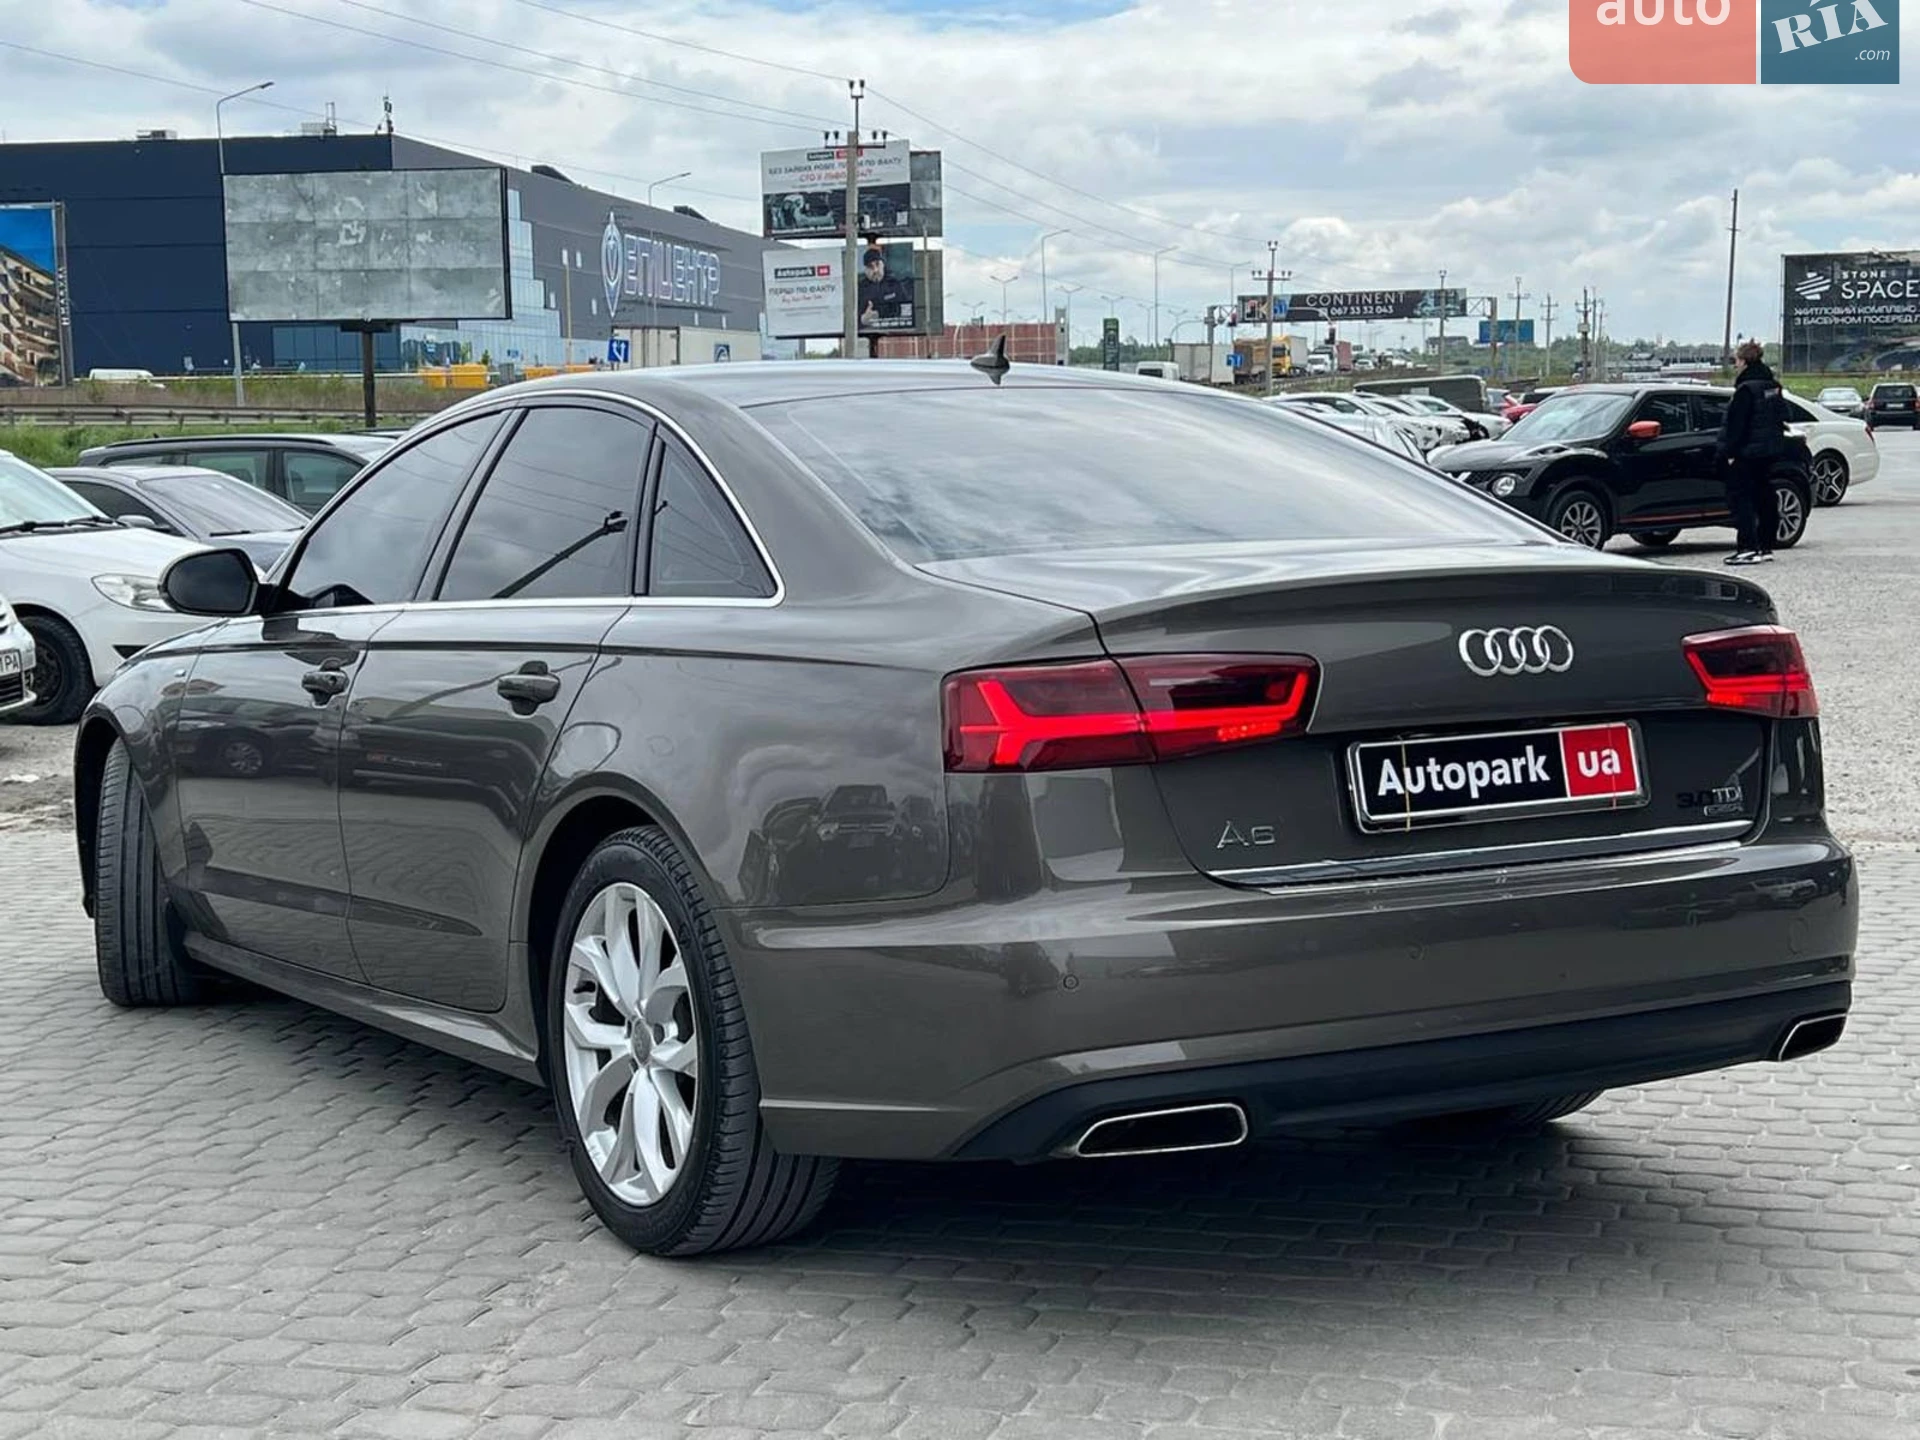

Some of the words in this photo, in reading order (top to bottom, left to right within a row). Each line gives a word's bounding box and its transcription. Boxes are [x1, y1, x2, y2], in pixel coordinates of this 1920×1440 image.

[624, 233, 720, 307] ЕПІЦЕНТР
[1306, 292, 1405, 306] CONTINENT
[1841, 280, 1920, 300] SPACE
[1794, 305, 1856, 316] ЖИТЛОВИЙ
[1377, 744, 1551, 799] Autopark
[1577, 747, 1622, 777] ua
[1217, 820, 1275, 849] A6
